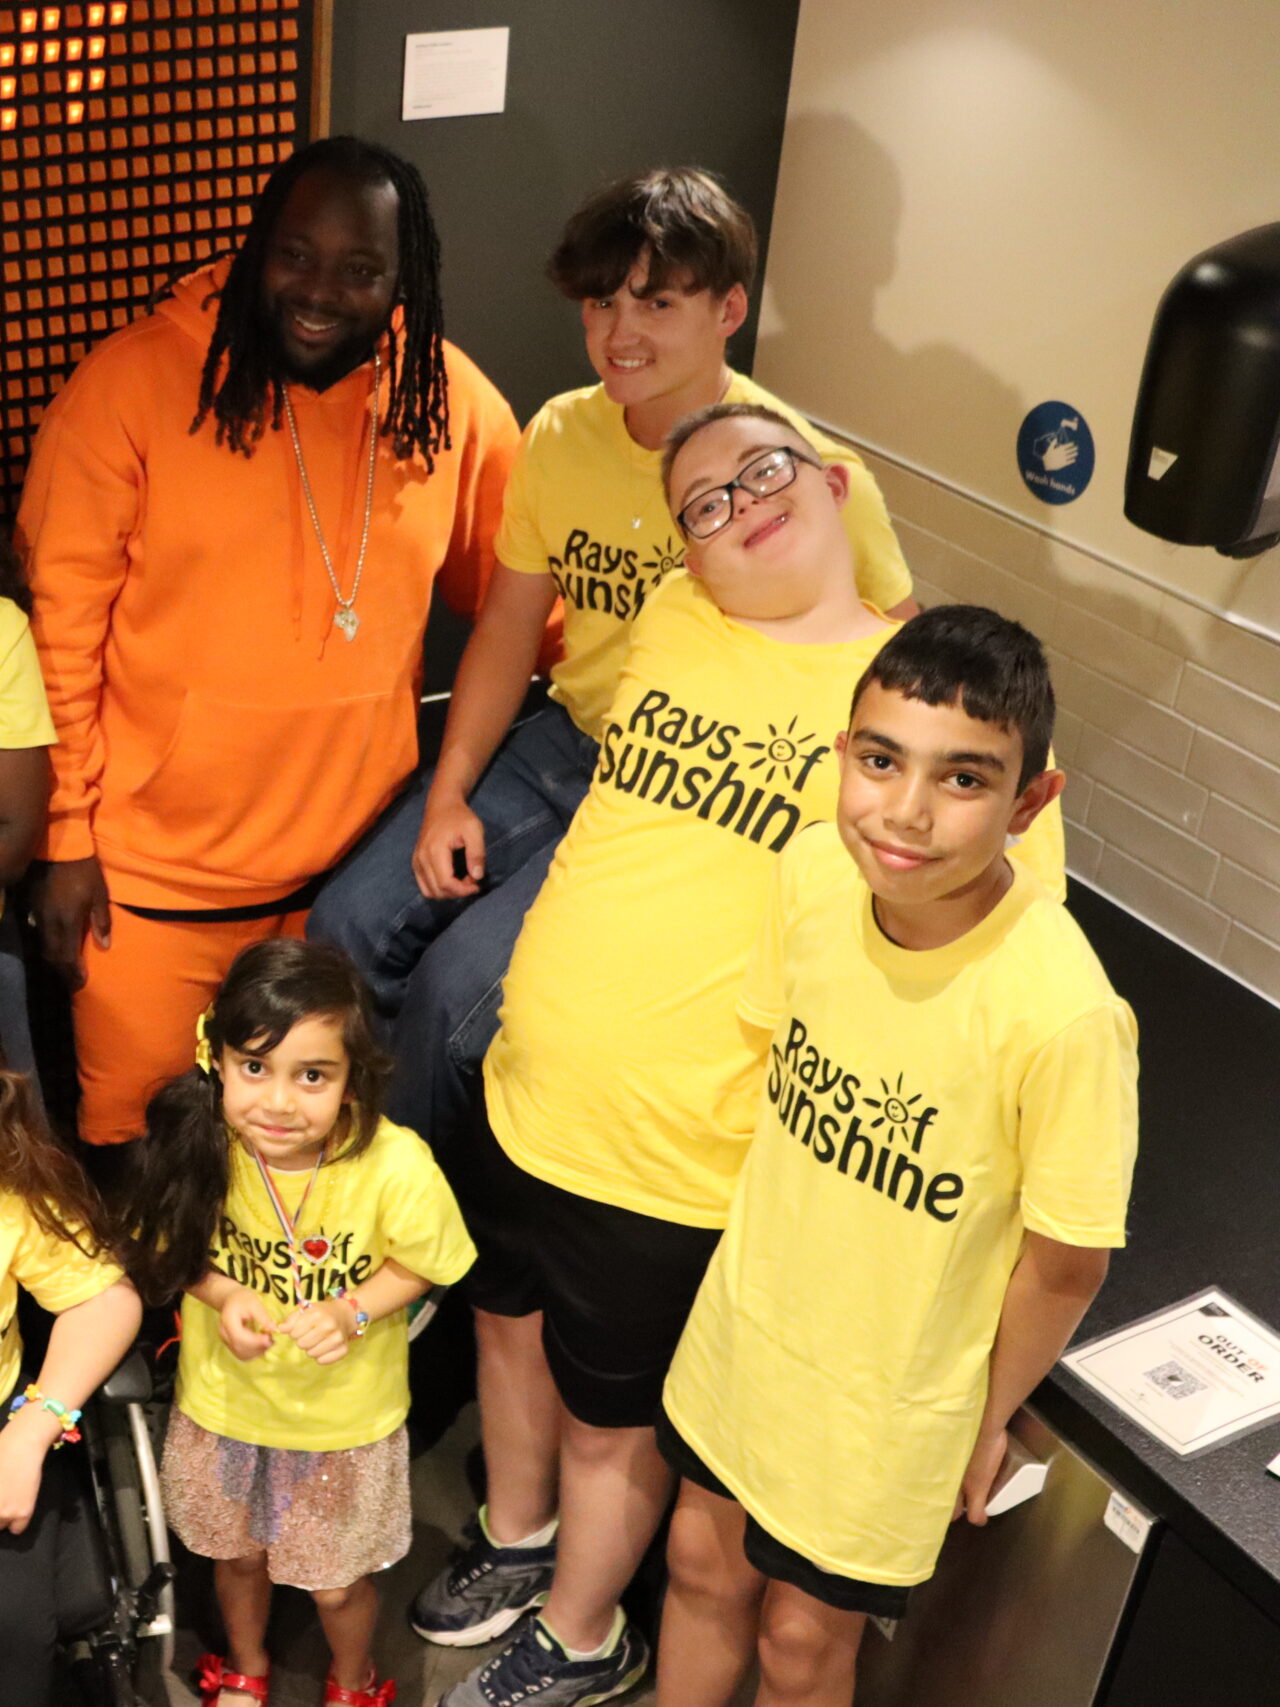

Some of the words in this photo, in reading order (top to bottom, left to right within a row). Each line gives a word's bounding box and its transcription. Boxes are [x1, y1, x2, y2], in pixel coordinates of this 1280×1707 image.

[564, 528, 638, 580] Rays
[628, 689, 740, 761] Rays
[599, 723, 826, 854] Sunshin
[785, 1017, 861, 1113] Rays
[768, 1043, 964, 1223] Sunshine
[220, 1216, 292, 1268] Rays
[1198, 1335, 1264, 1383] ORDER
[1216, 1335, 1247, 1355] OUT
